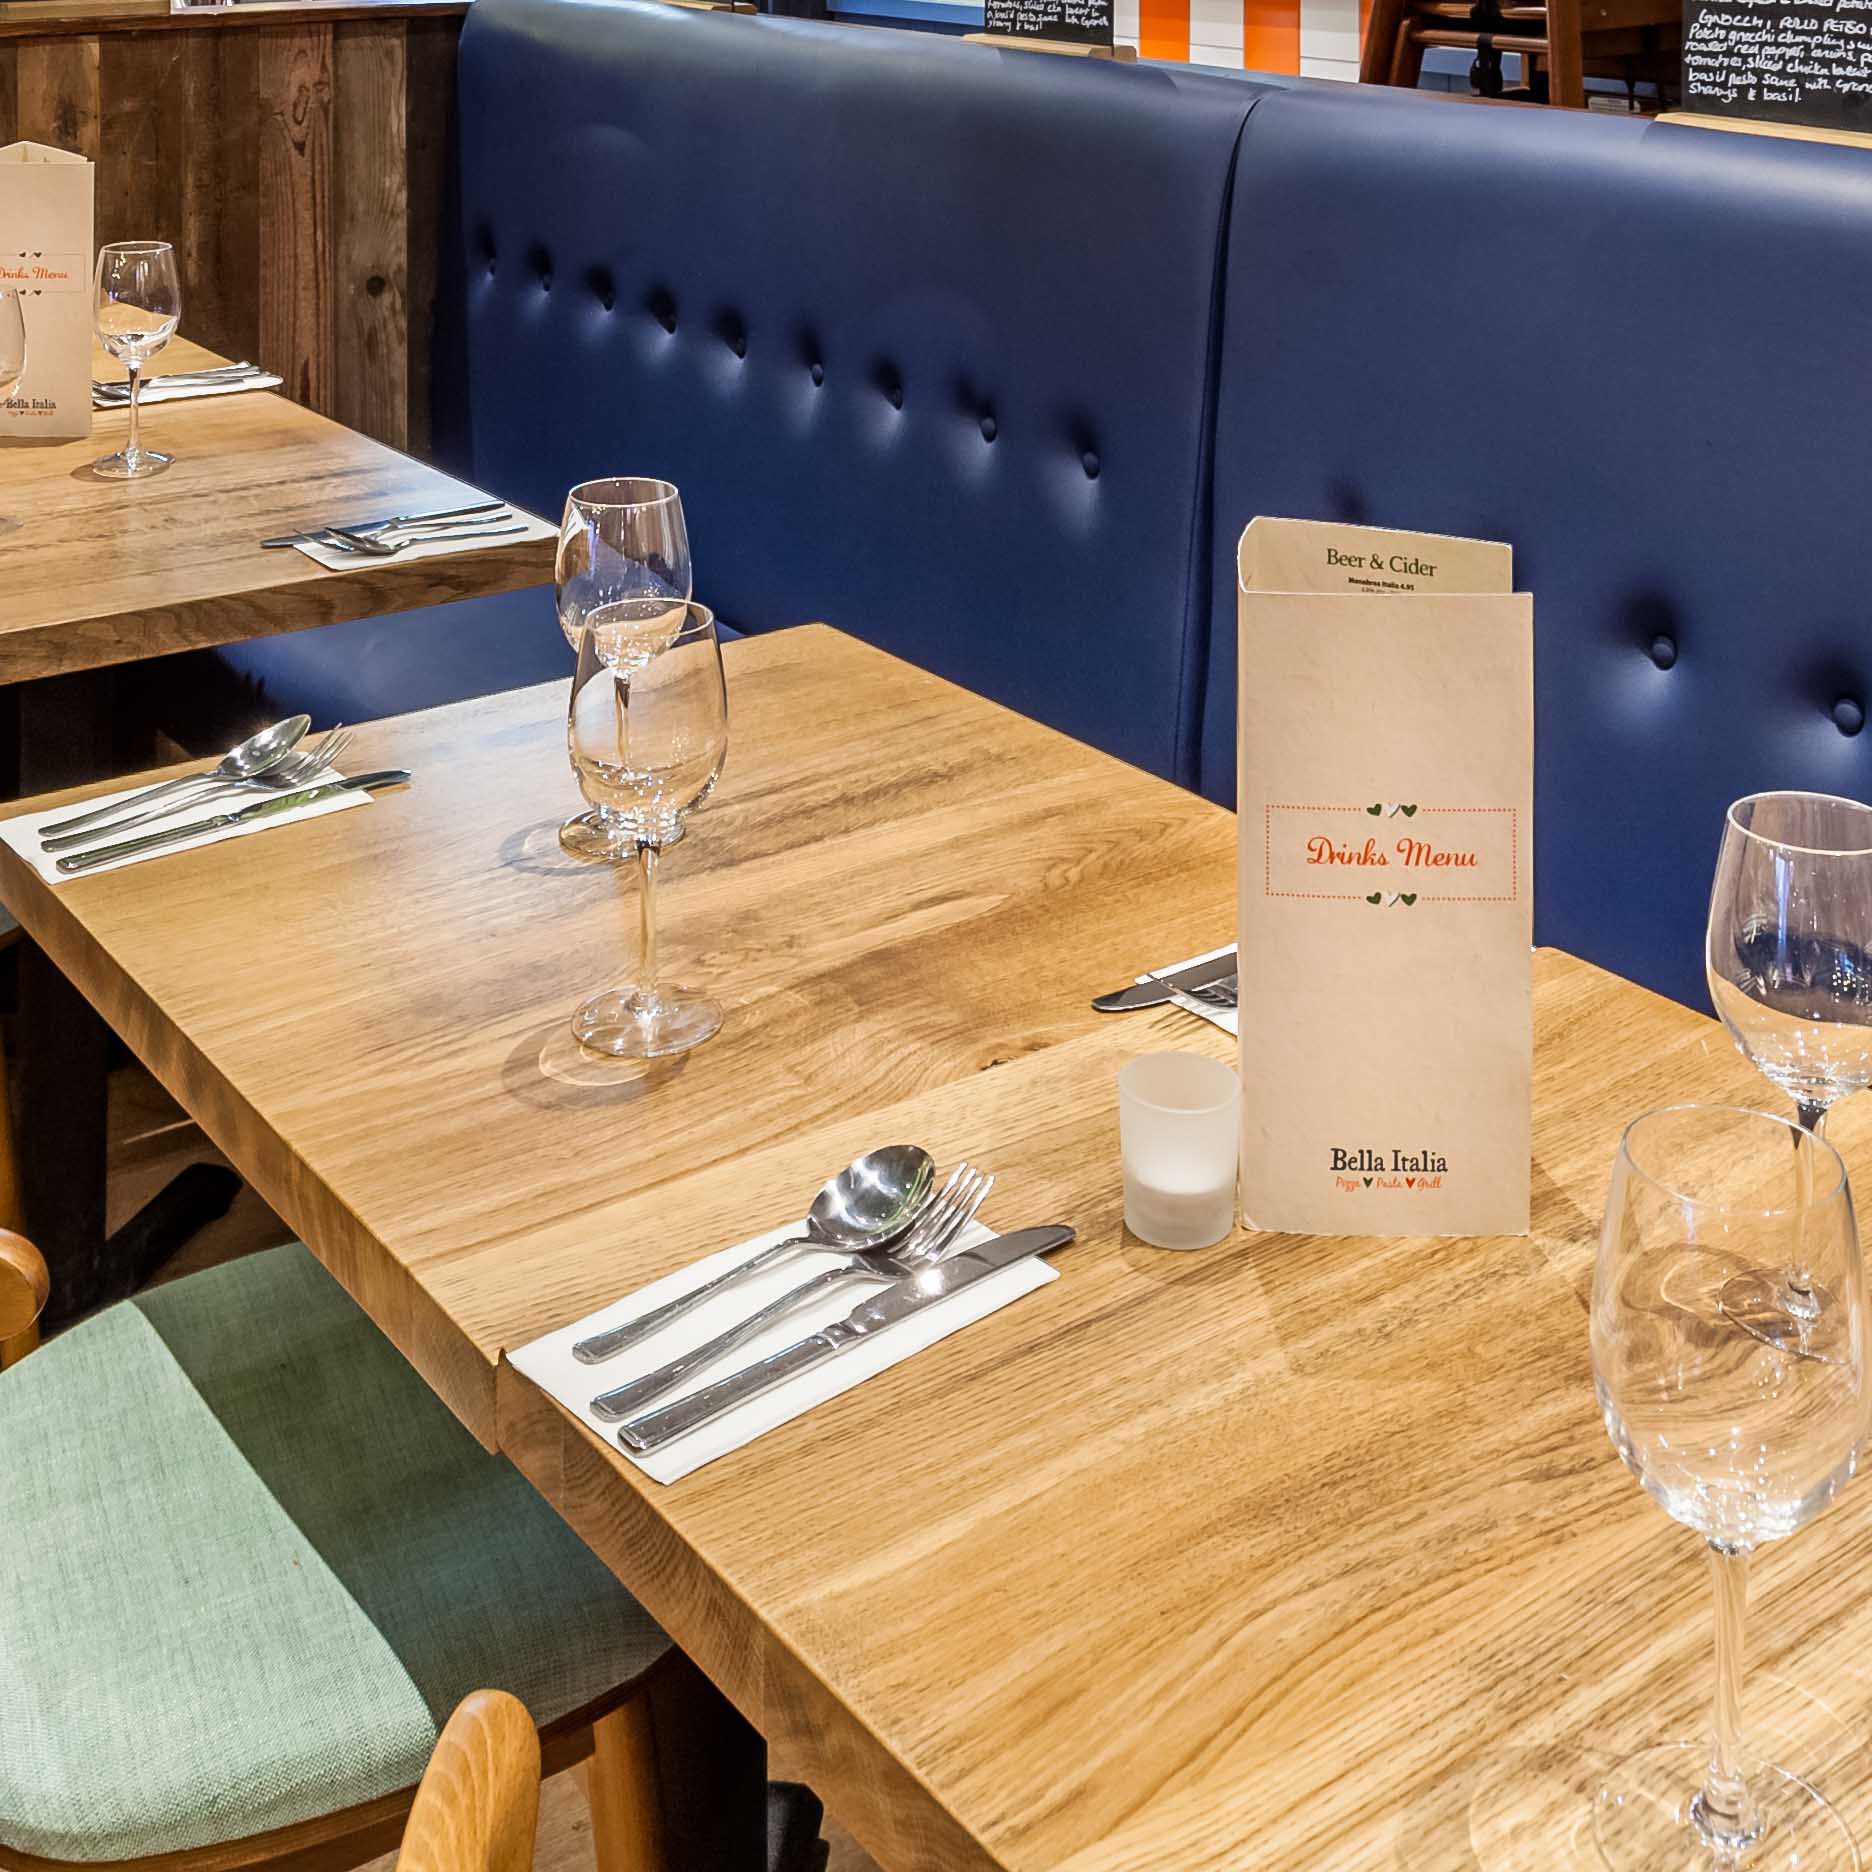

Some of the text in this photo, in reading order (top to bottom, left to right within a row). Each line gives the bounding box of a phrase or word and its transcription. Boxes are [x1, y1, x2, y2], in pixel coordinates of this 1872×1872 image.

[5, 398, 57, 409] Bella Italia
[1326, 547, 1438, 577] Beer & Cider
[1306, 836, 1478, 867] Drinks Menu
[1329, 1147, 1449, 1173] Bella Italia
